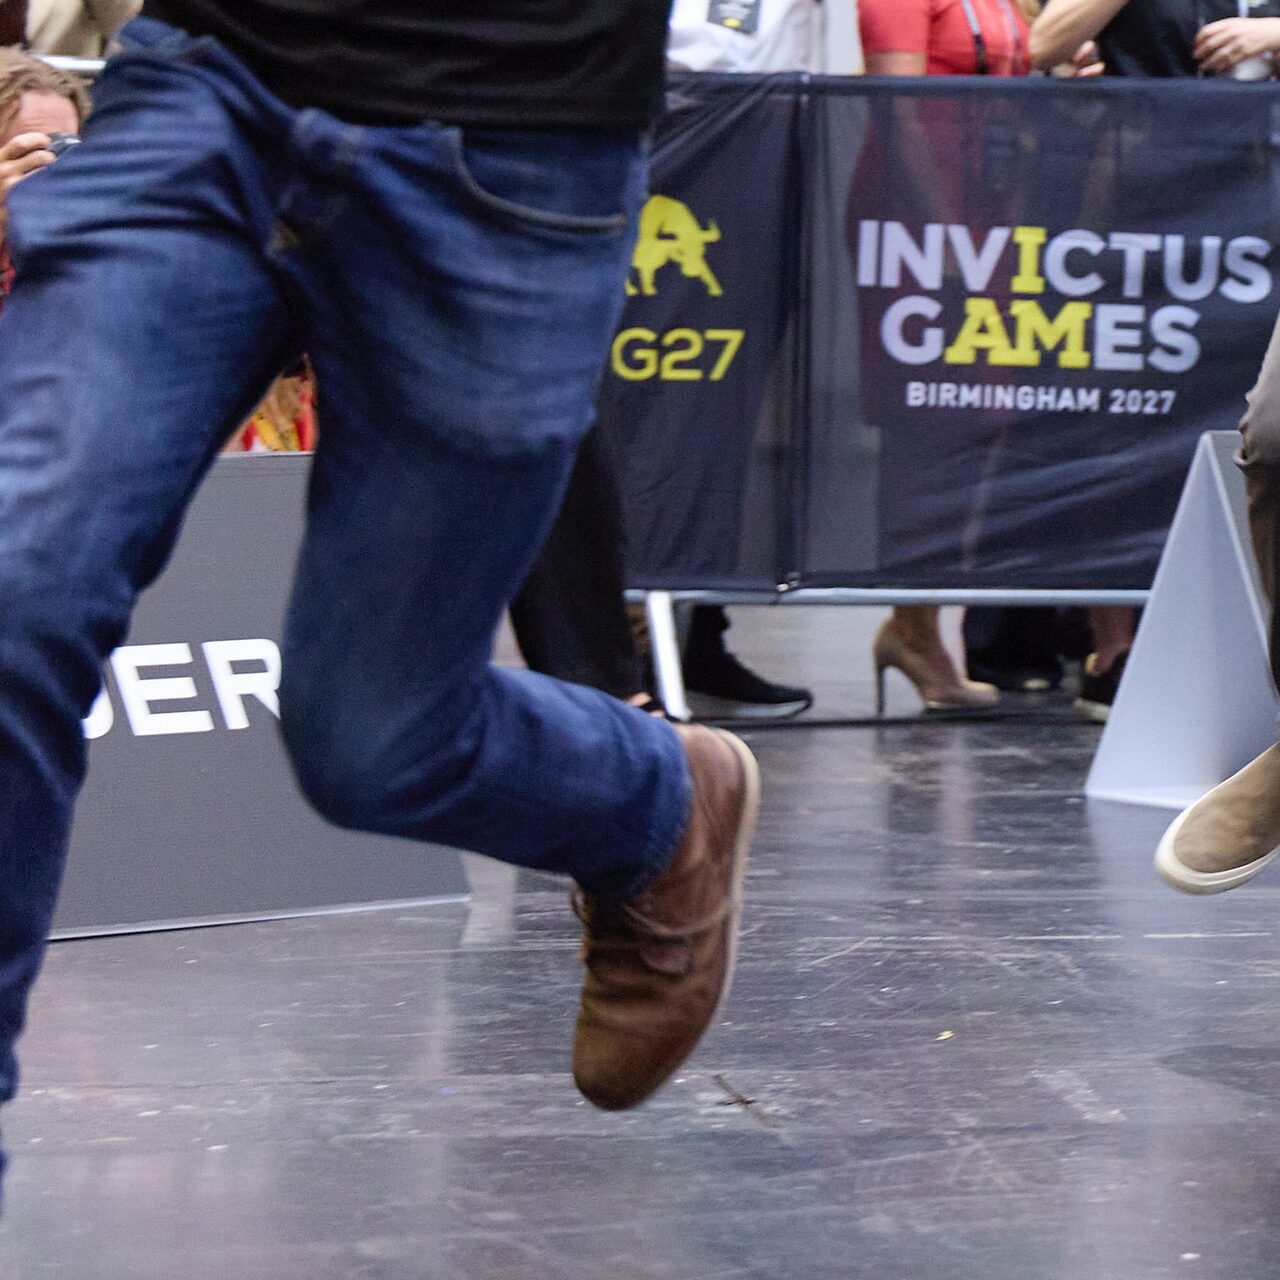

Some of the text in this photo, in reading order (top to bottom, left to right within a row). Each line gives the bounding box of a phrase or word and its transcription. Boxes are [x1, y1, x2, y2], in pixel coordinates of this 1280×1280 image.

[857, 220, 1273, 303] INVICTUS
[881, 295, 1201, 373] GAMES
[906, 381, 1176, 415] BIRMINGHAM 2027
